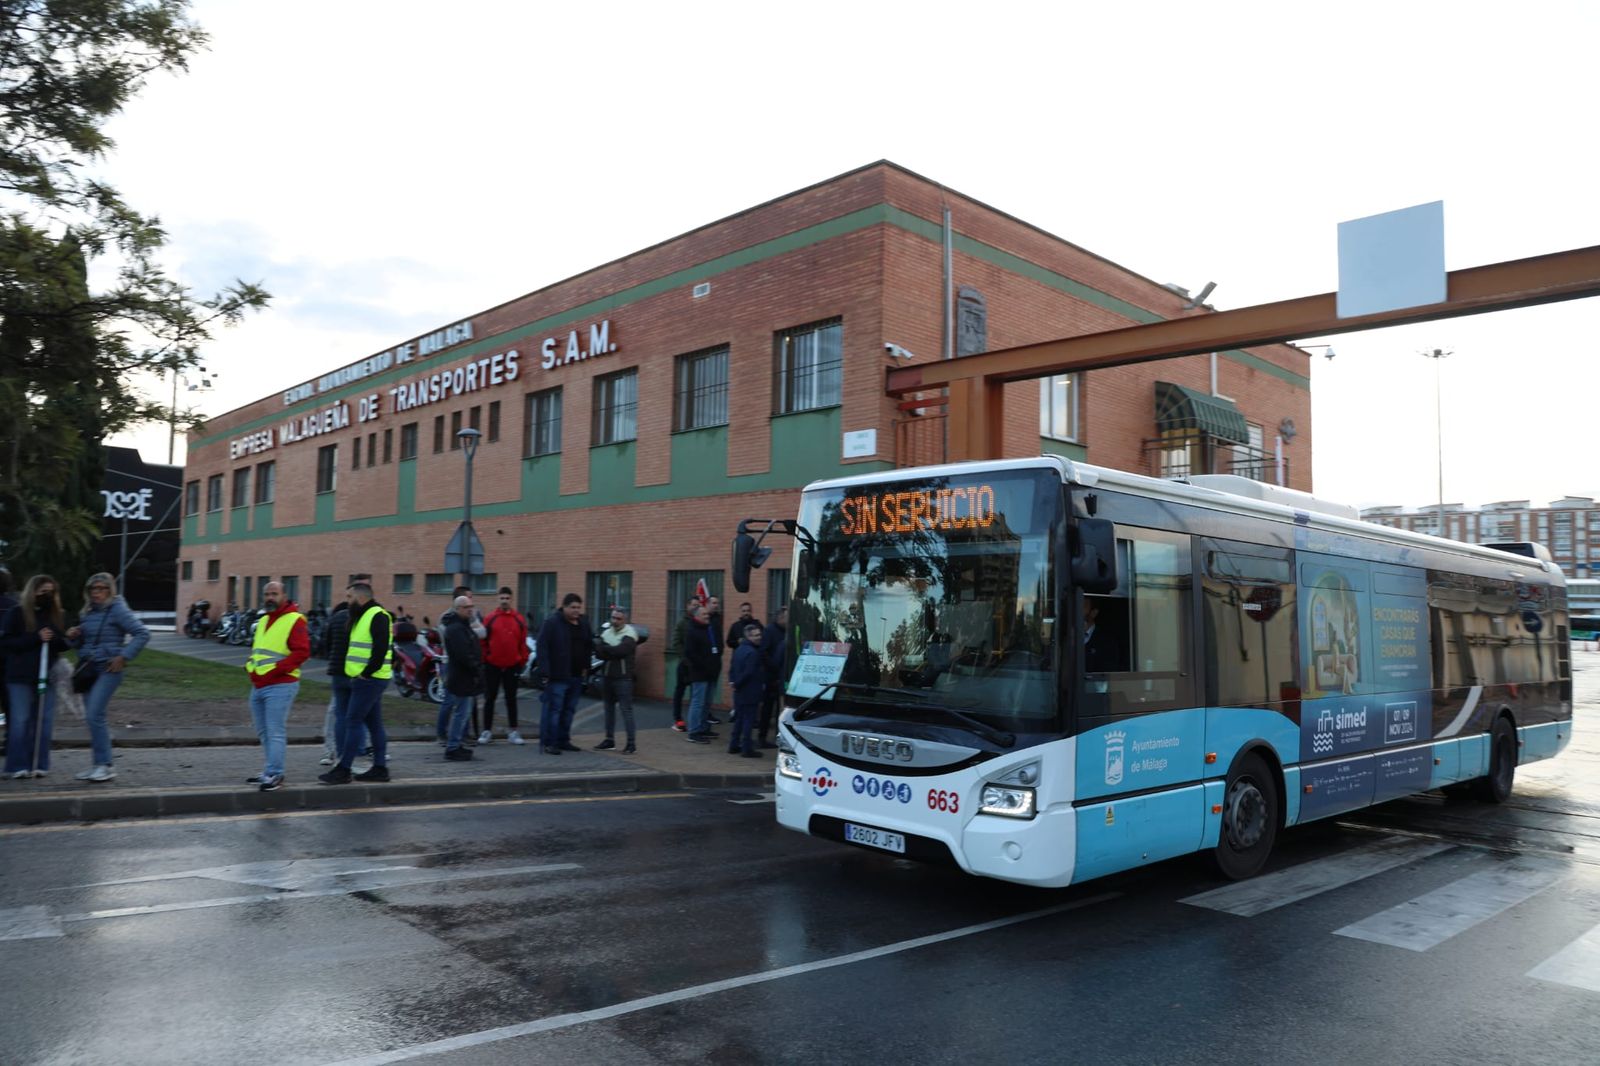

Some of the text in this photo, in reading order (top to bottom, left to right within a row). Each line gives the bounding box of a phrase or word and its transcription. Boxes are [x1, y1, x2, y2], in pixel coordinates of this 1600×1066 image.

[396, 343, 415, 364] DE
[230, 320, 617, 460] EMPRESA MALAGUEÑA DE TRANSPORTES S.A.M.
[840, 485, 994, 535] SIN SERVICIO
[1336, 706, 1367, 730] simed
[1389, 724, 1401, 735] NOV
[841, 733, 914, 762] IVECO
[1131, 736, 1180, 754] Ayuntamiento
[1130, 759, 1168, 773] de Málaga
[927, 788, 960, 814] 663
[852, 827, 879, 845] 2602
